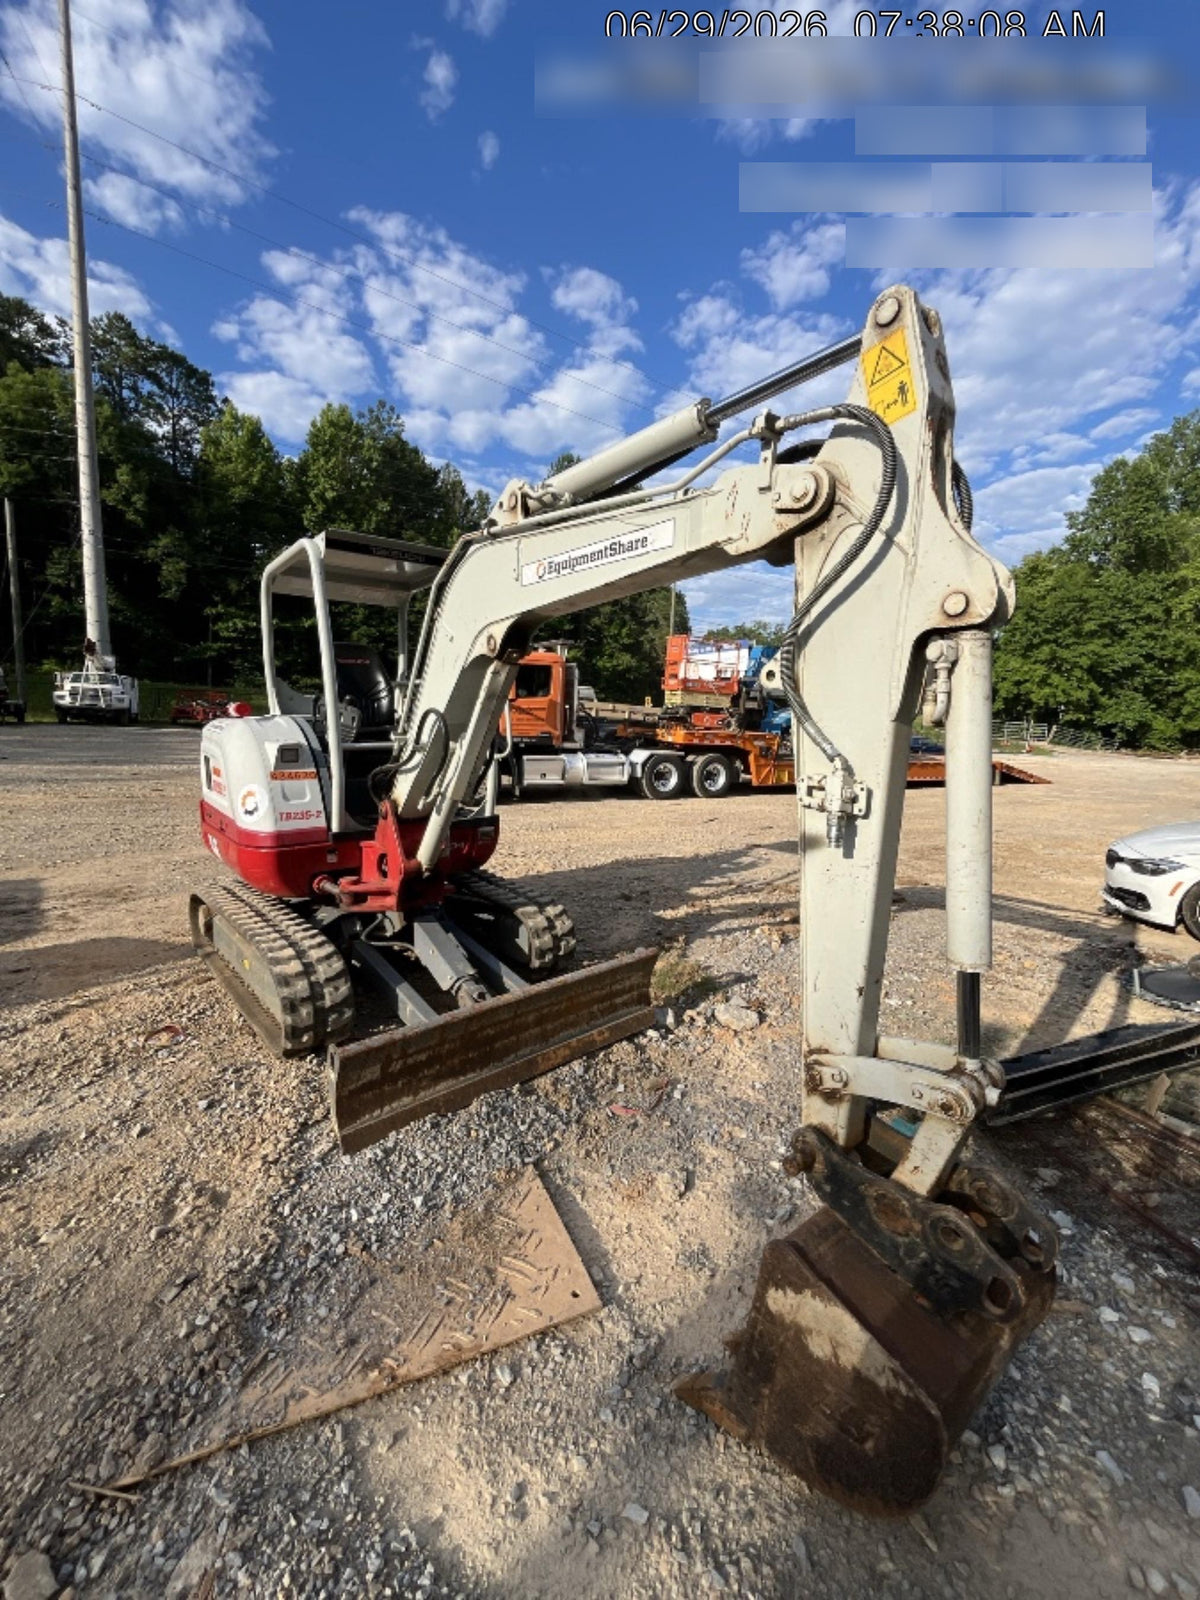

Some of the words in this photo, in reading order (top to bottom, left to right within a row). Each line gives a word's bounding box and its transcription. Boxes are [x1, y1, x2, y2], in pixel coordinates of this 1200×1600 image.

[370, 547, 426, 563] TUCH
[547, 535, 649, 575] EquipmentShare
[279, 810, 322, 821] TB235-2
